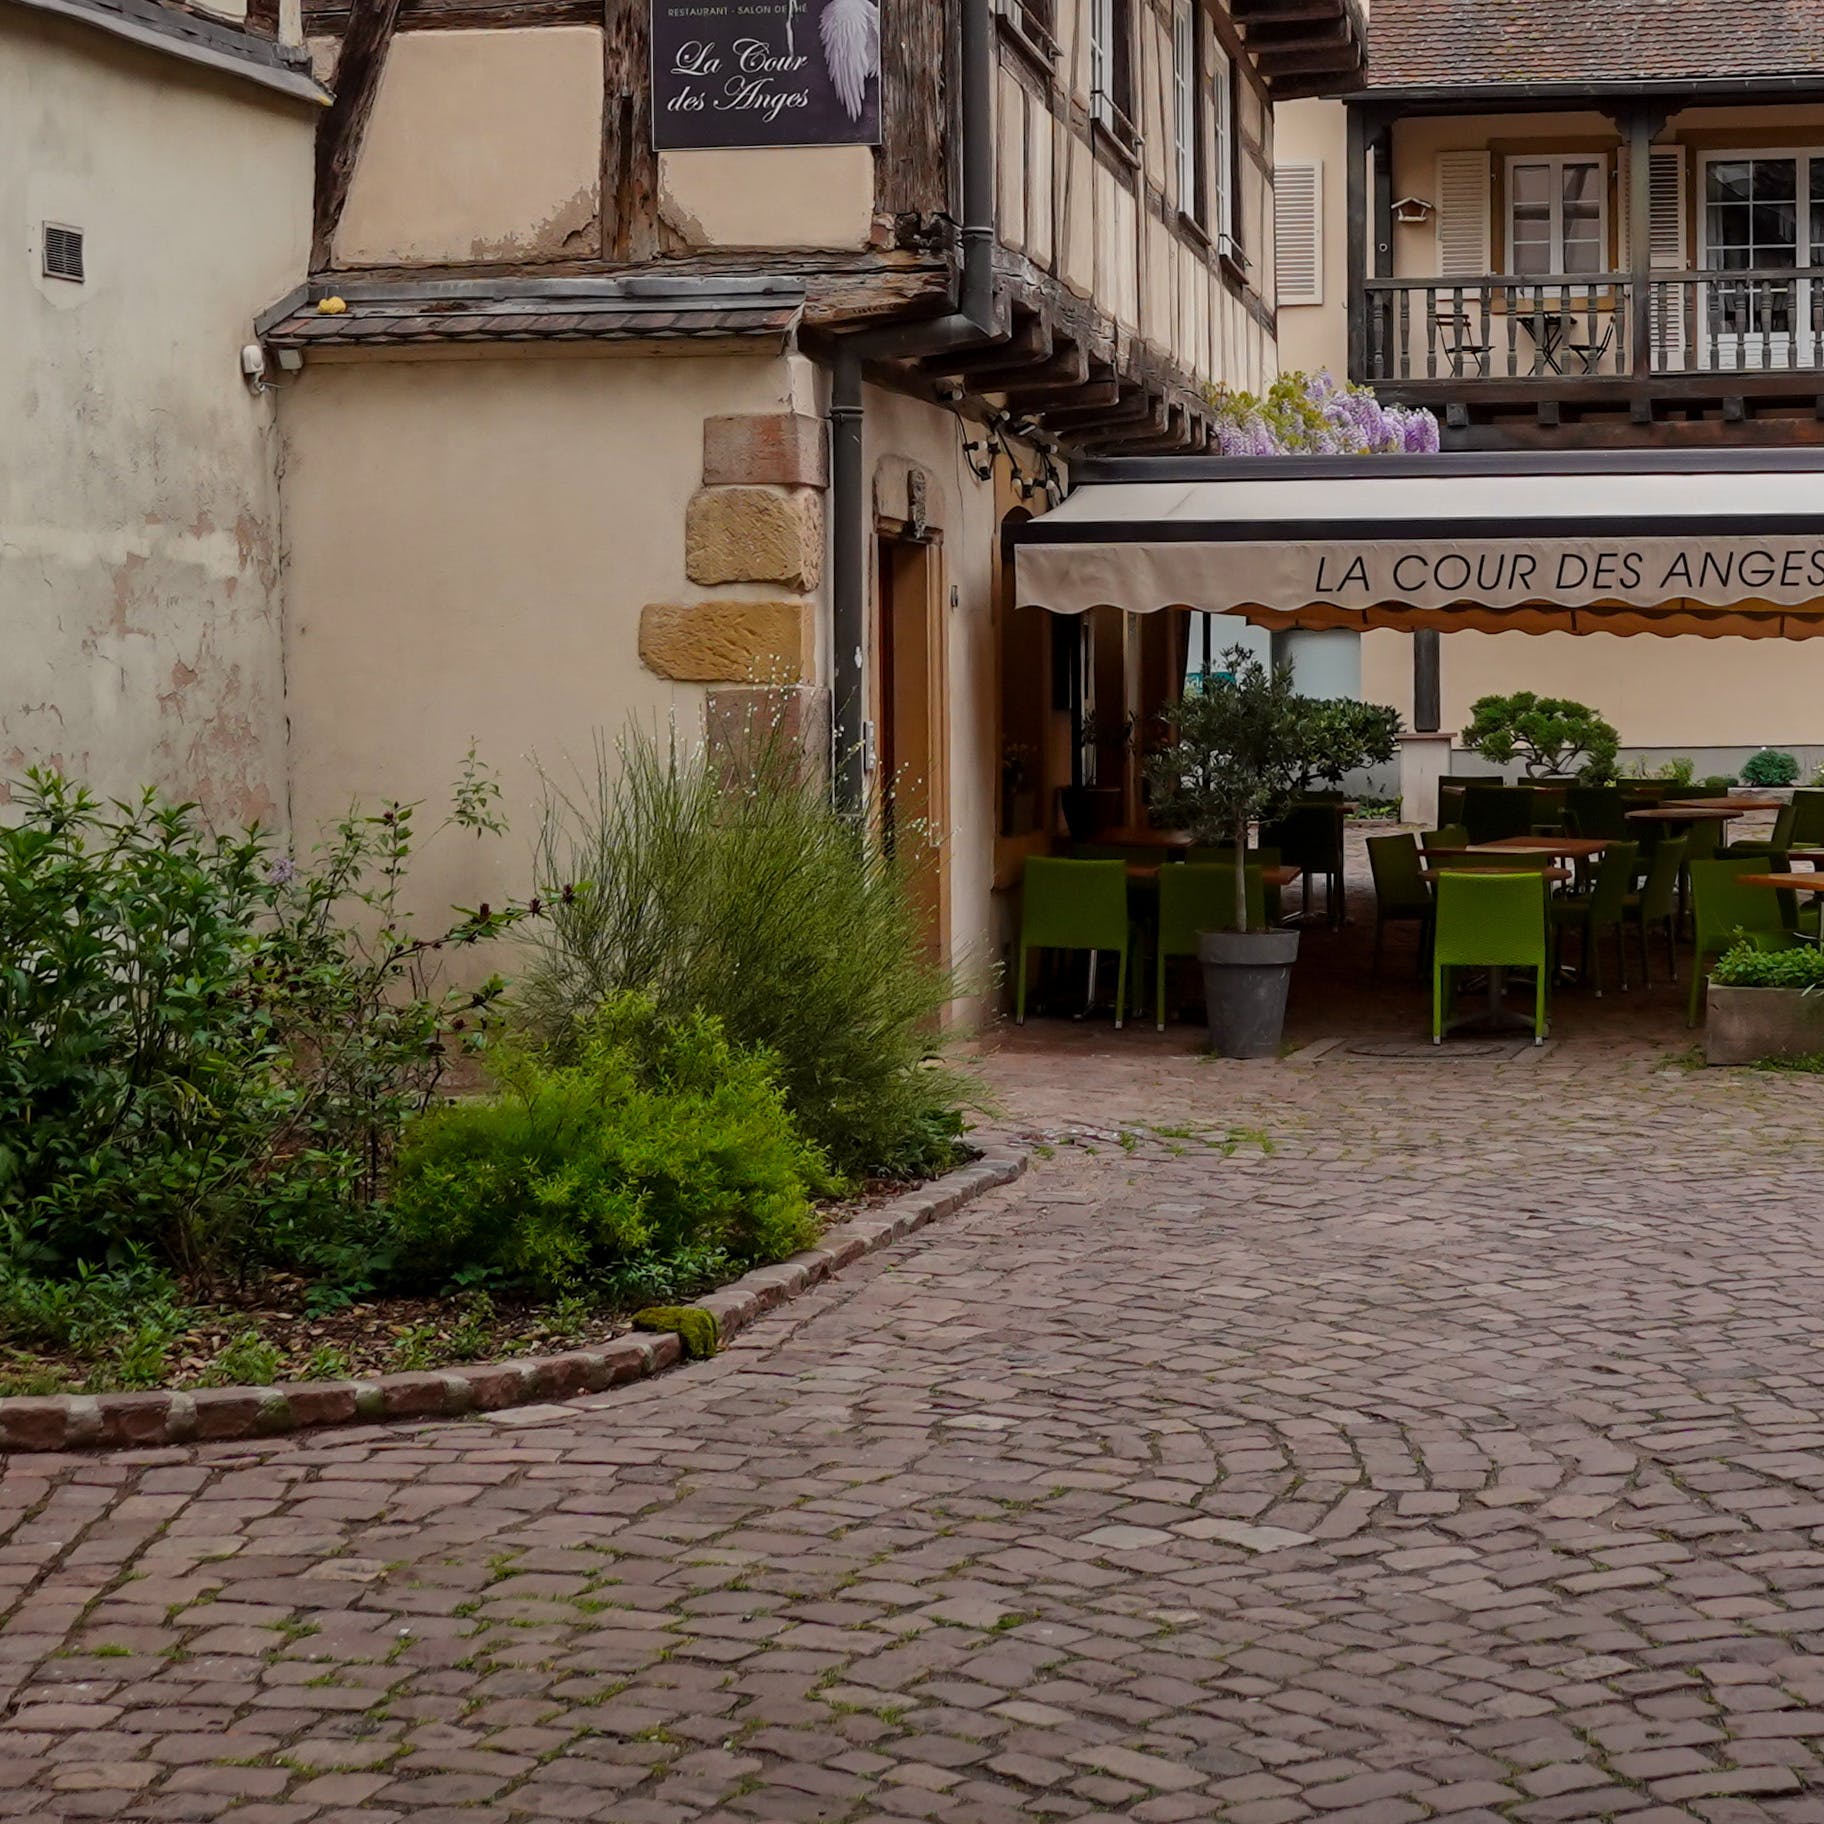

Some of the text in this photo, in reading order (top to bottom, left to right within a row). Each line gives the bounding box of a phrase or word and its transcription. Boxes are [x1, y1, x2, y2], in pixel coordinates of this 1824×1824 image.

[668, 7, 728, 17] RESTAURANT
[737, 4, 771, 15] SALON
[670, 37, 808, 76] La Cour
[667, 74, 809, 123] des Anges
[1314, 556, 1371, 593] LA
[1392, 553, 1537, 592] COUR
[1555, 551, 1643, 591] DES
